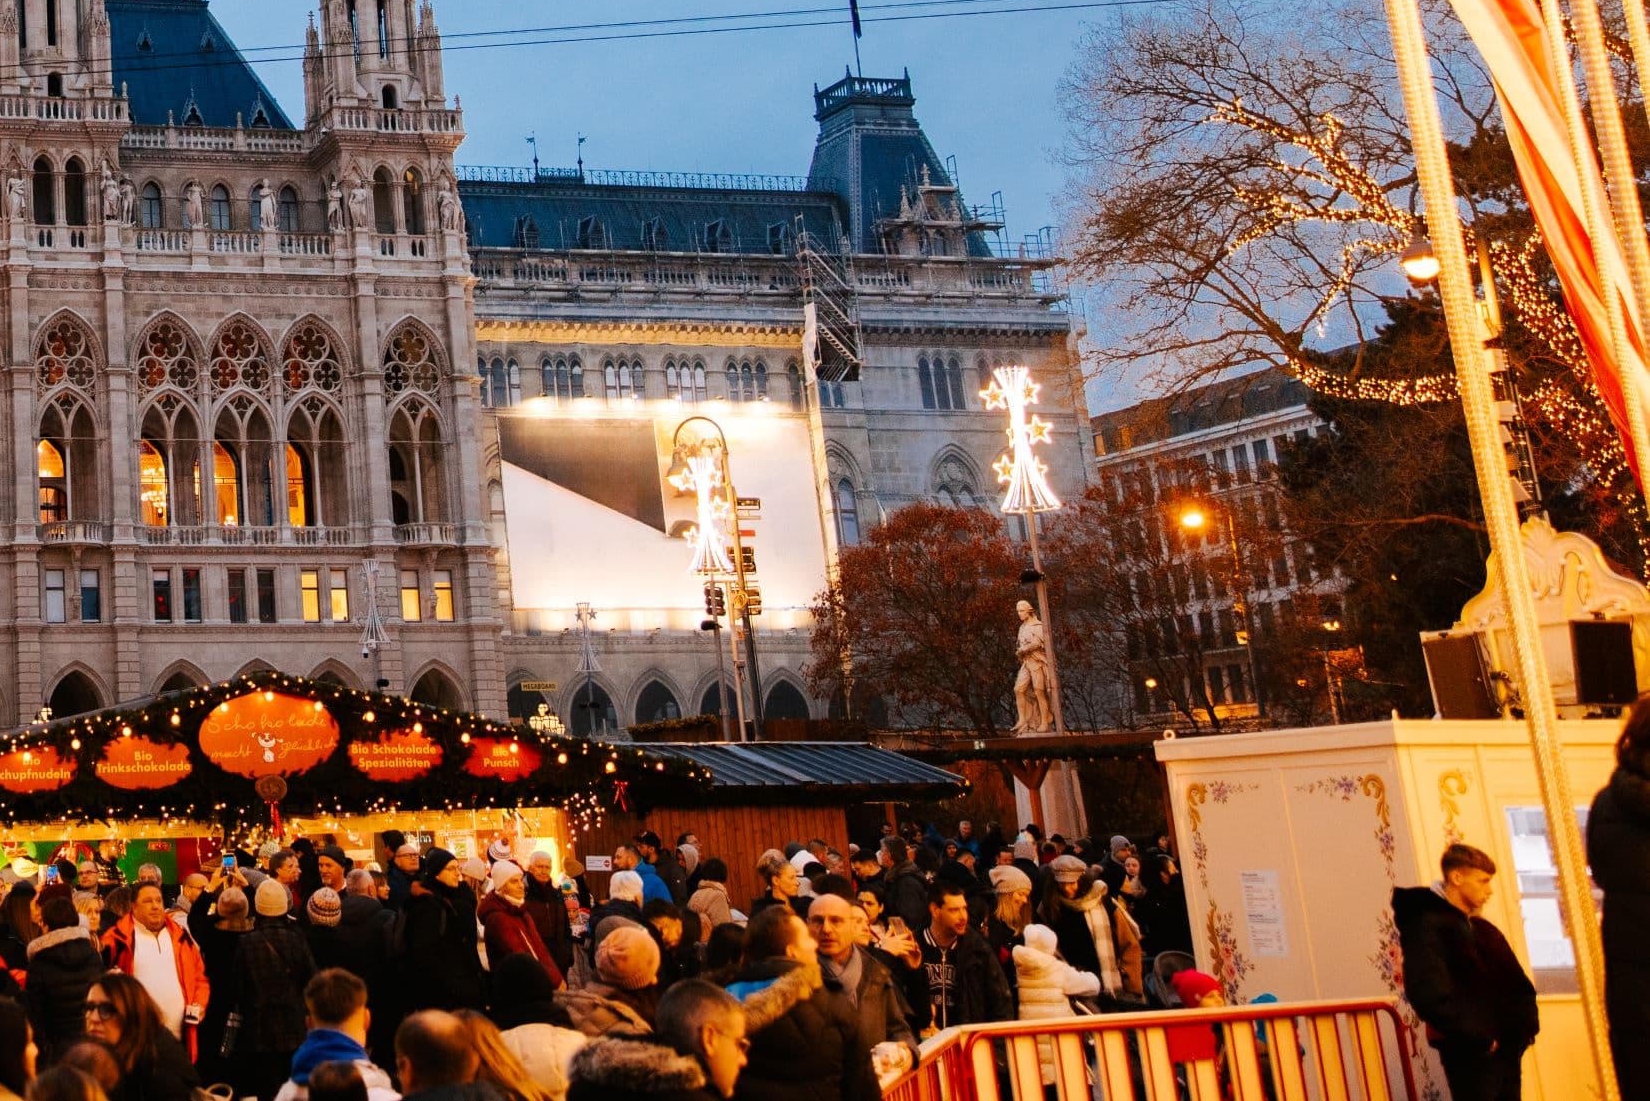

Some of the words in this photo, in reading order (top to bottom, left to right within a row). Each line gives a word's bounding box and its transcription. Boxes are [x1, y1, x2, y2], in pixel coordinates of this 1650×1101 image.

[351, 744, 369, 755] Bio
[372, 743, 437, 755] Schokolade
[492, 747, 509, 757] Bio
[134, 751, 153, 761] Bio
[96, 761, 191, 774] Trinkschokolade
[358, 757, 431, 768] Spezialitäten
[484, 757, 520, 768] Punsch
